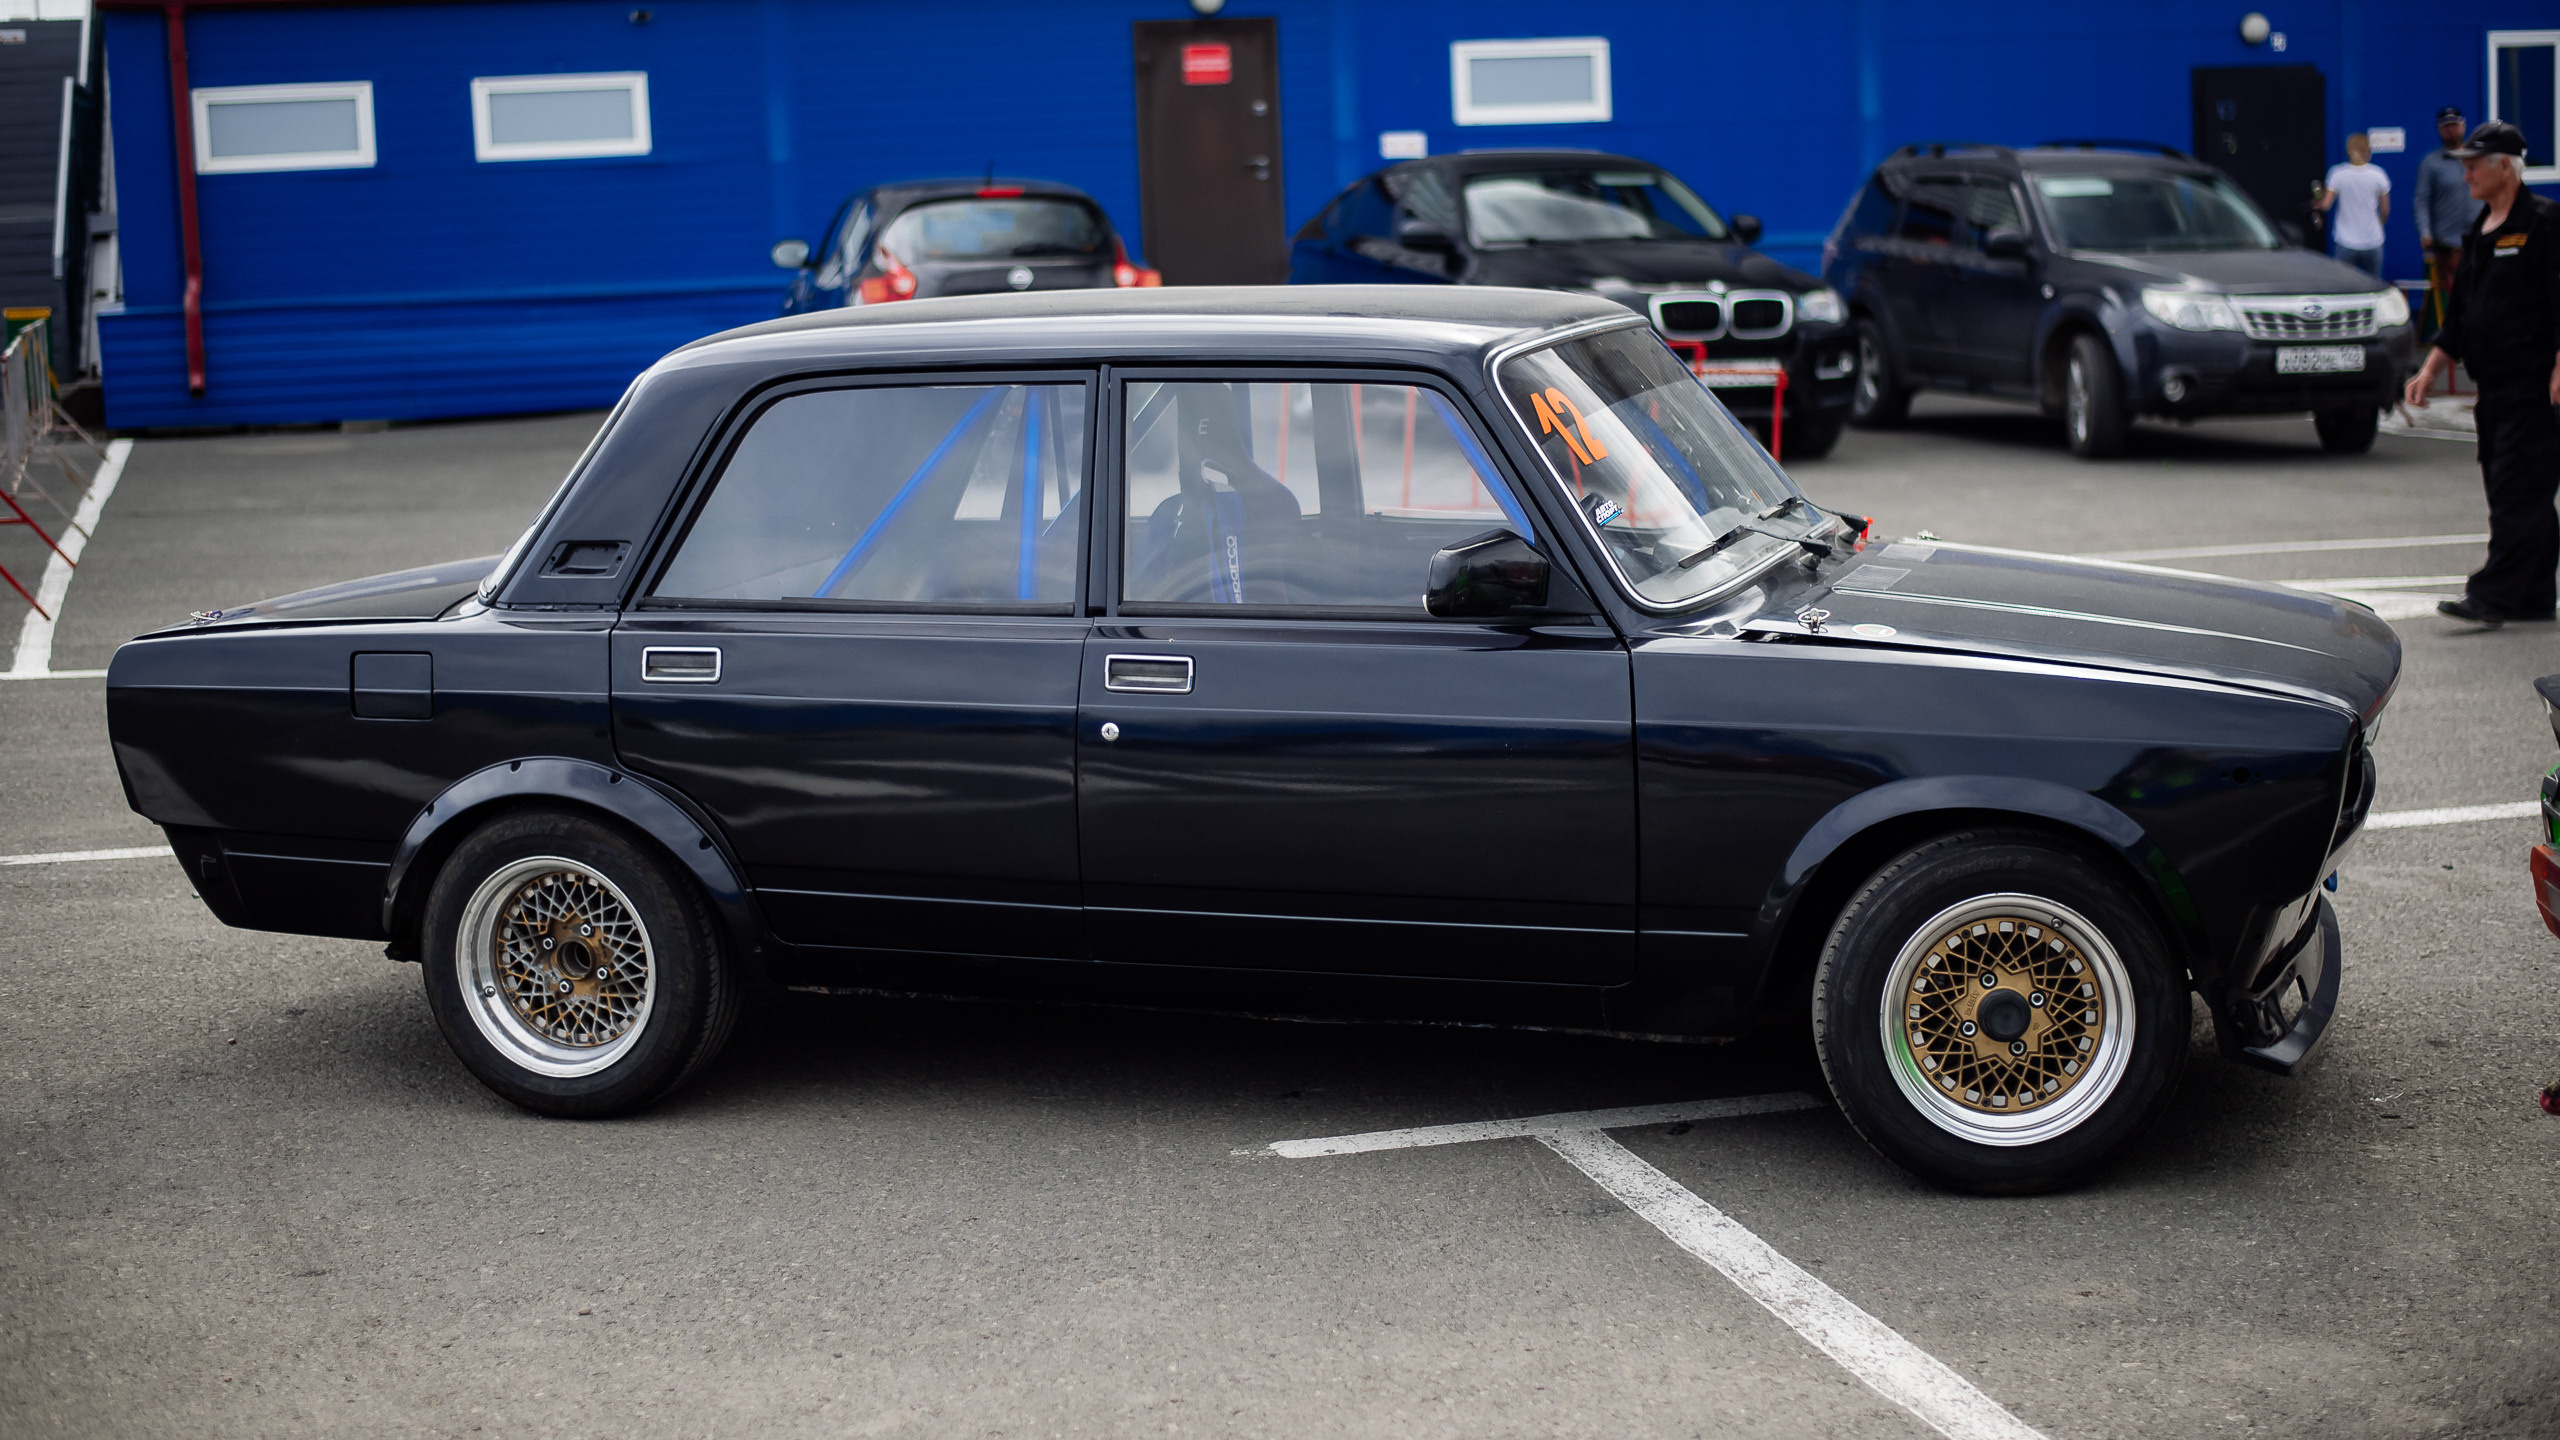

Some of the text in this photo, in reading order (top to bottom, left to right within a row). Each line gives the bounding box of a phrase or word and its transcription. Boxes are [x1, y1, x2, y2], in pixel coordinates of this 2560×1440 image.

[1530, 387, 1608, 465] 12
[1595, 499, 1614, 517] АВТО
[1596, 504, 1618, 524] СПОРТ
